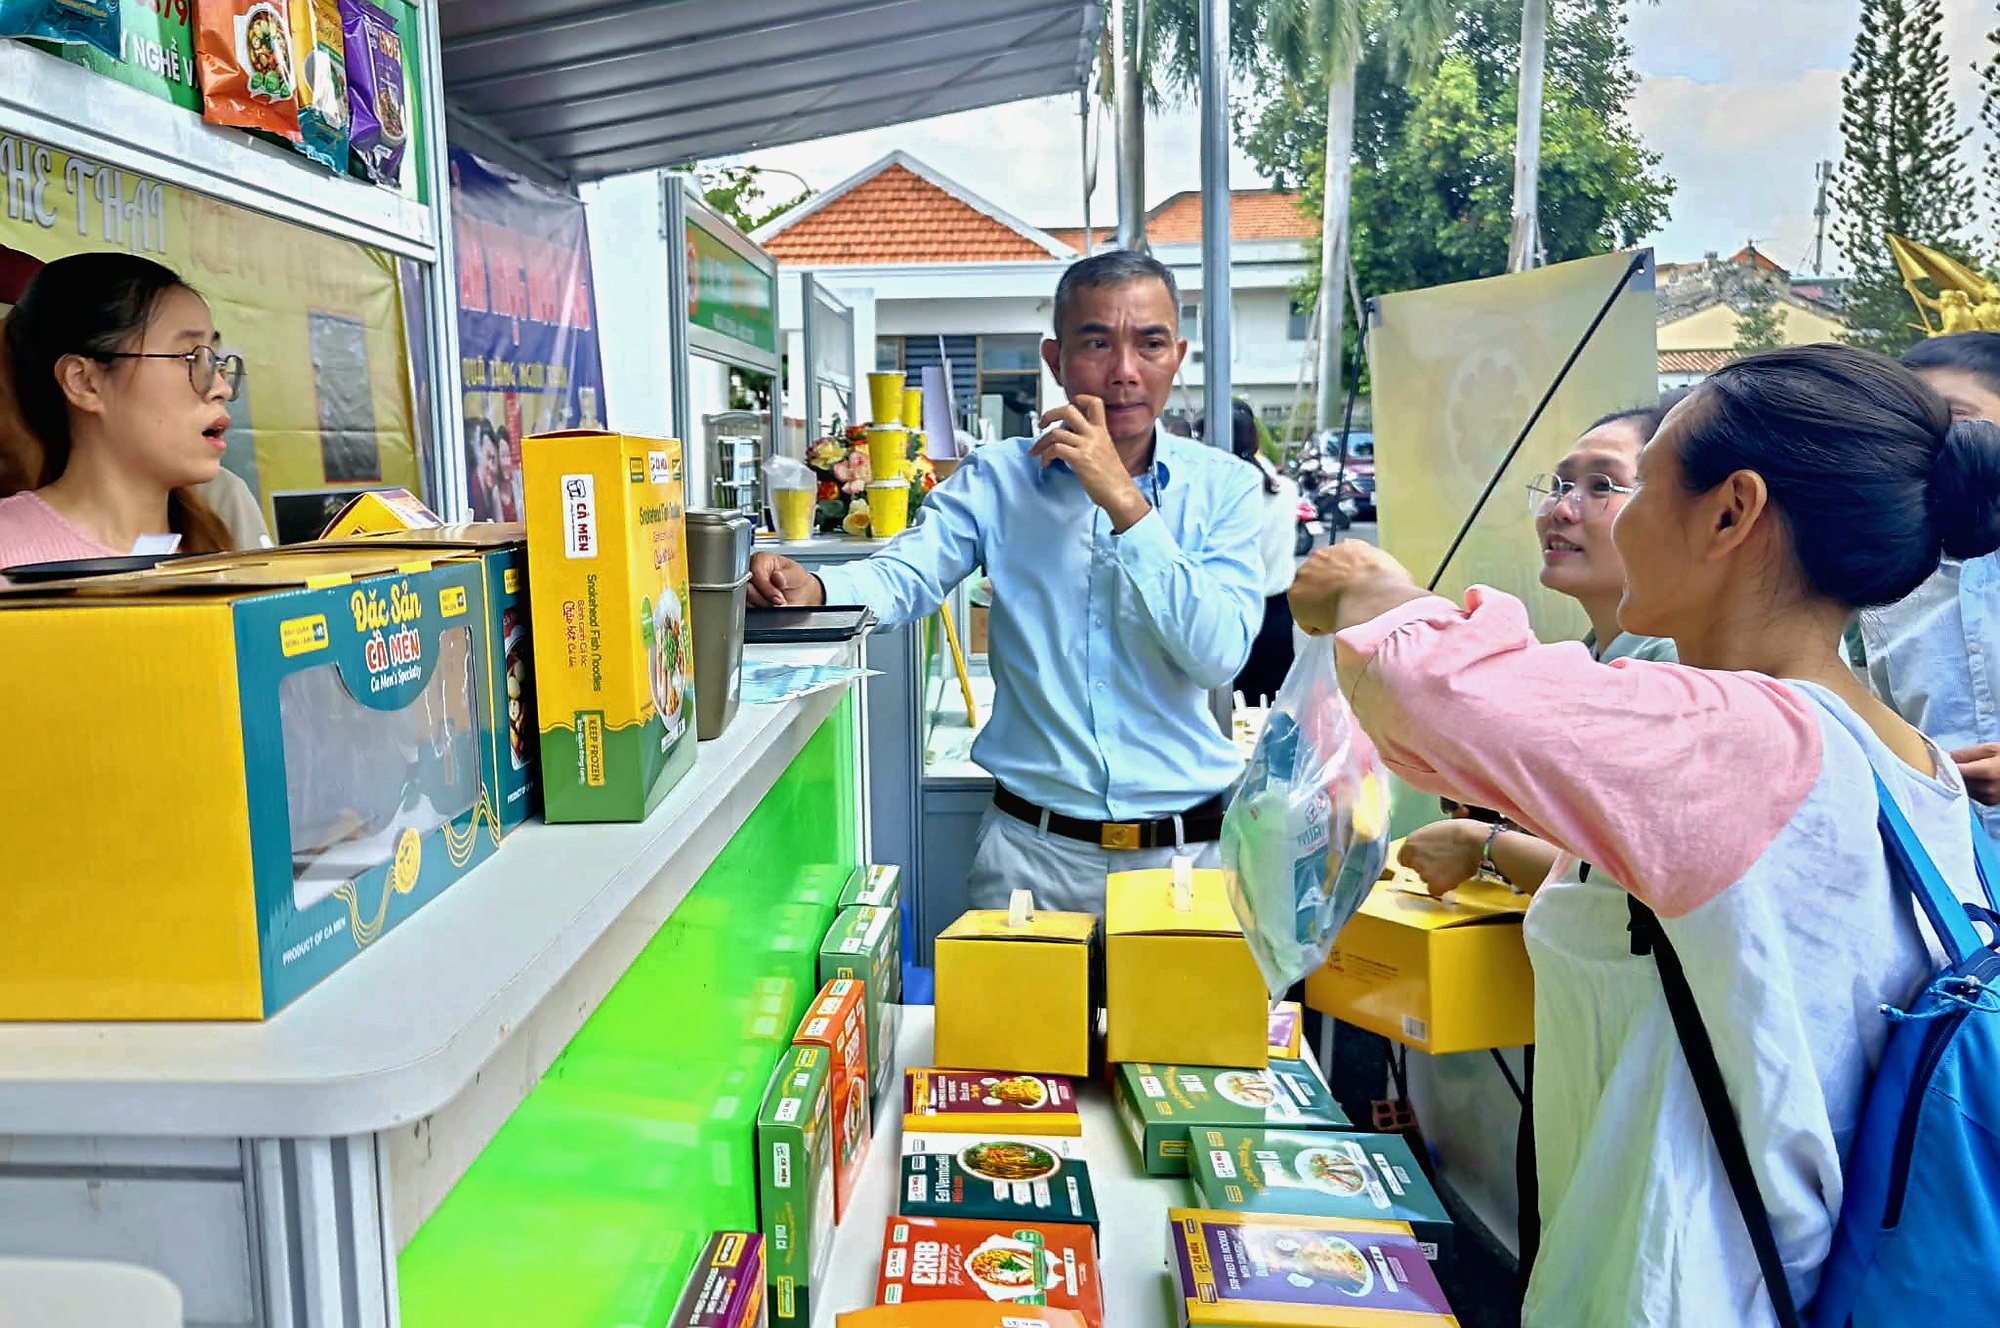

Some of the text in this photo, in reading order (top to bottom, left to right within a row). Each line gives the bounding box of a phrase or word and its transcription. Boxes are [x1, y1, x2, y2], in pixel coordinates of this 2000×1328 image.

[576, 503, 590, 519] CÀ
[351, 588, 389, 634] Đặc
[390, 579, 422, 625] Sản
[586, 573, 602, 692] Snakehead Fish Noodles
[365, 628, 388, 674] CÀ
[389, 623, 421, 666] MÈN
[371, 677, 380, 693] Ca
[588, 719, 600, 782] KEEP FROZEN
[283, 915, 347, 968] PRODUCT OF CA MEN
[911, 1241, 939, 1285] CRAB
